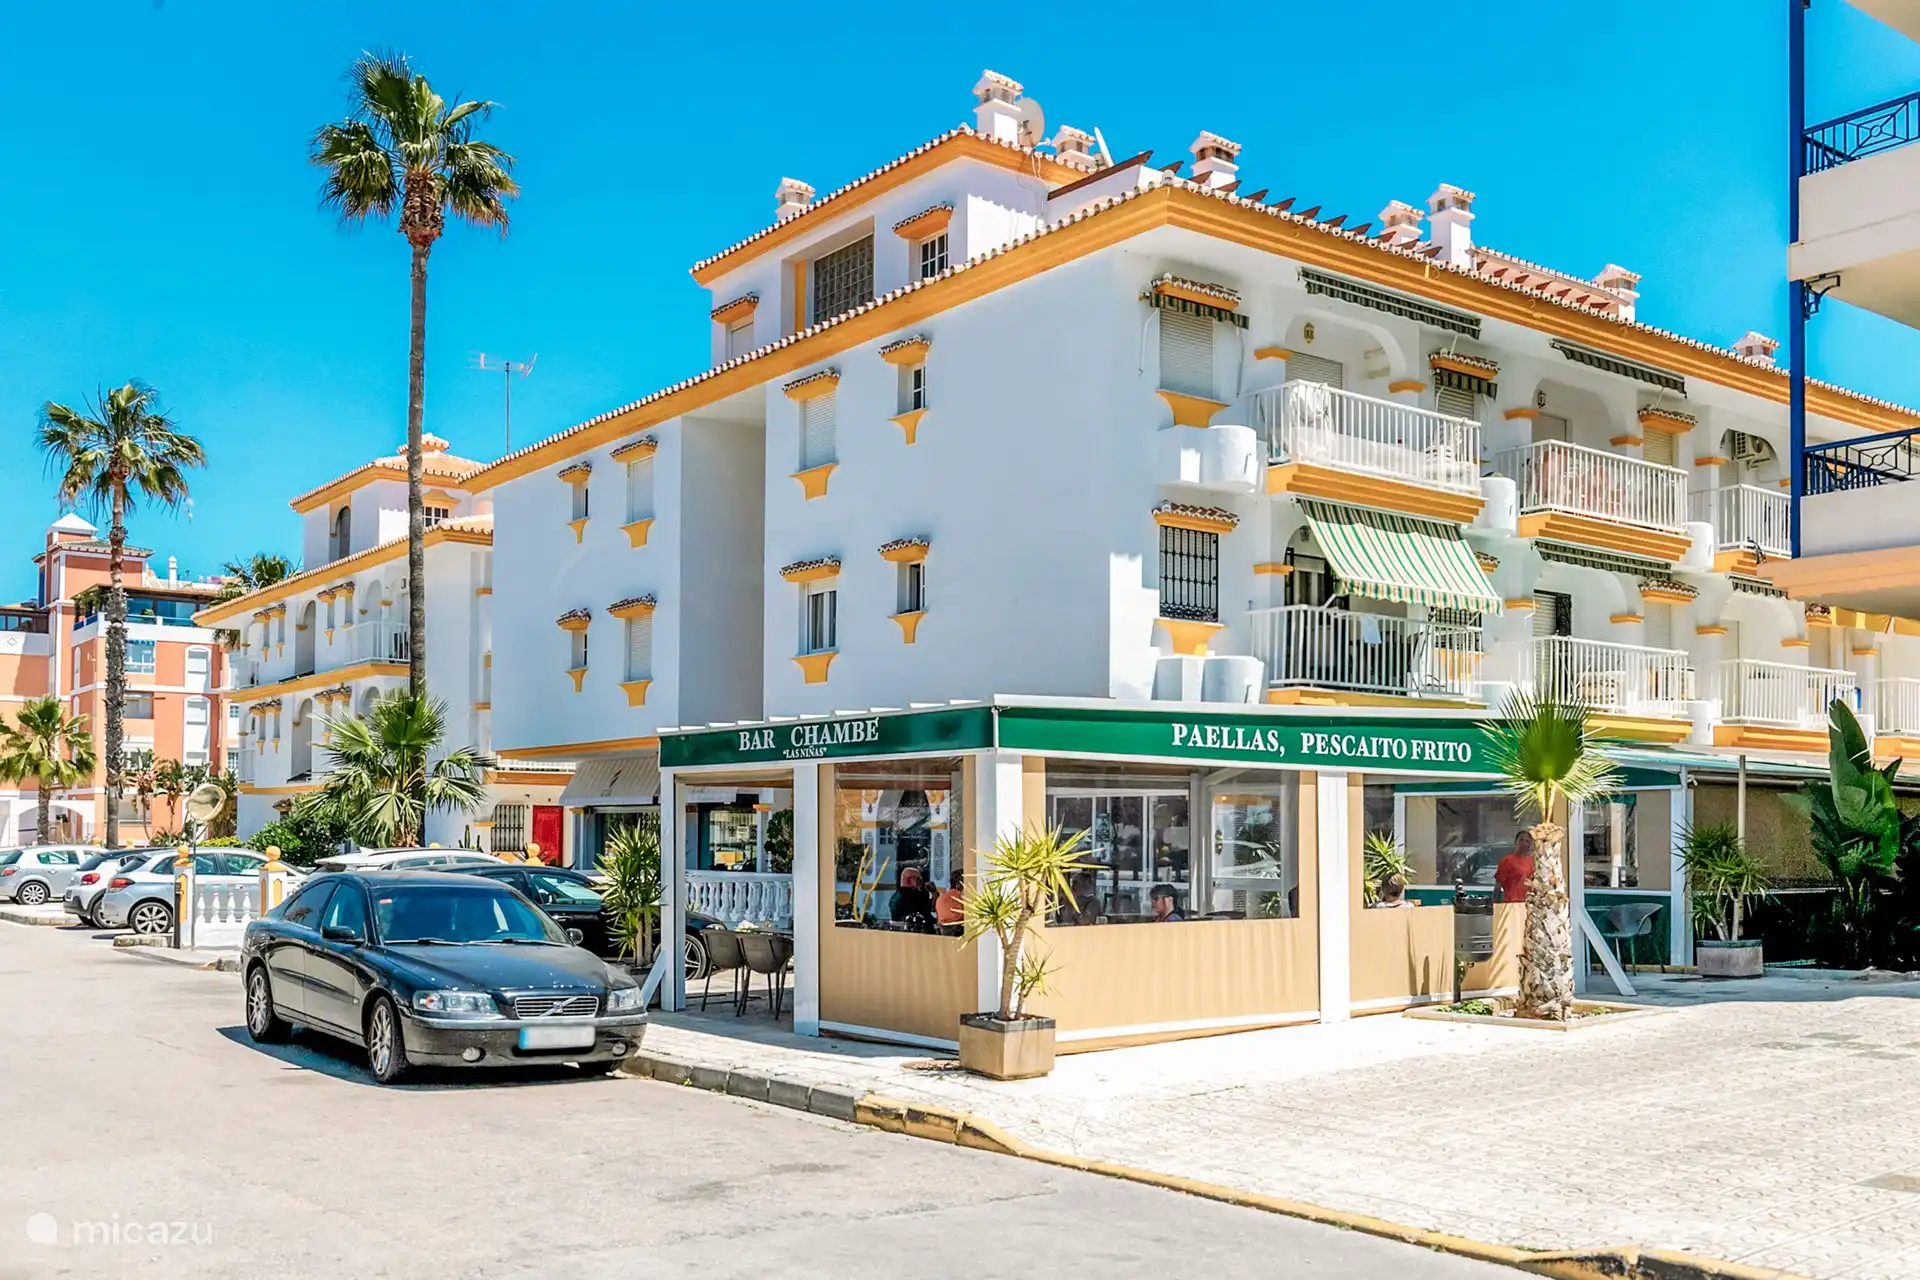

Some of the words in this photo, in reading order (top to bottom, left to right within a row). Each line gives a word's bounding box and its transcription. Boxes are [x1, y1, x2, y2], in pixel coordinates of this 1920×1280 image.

[738, 729, 776, 751] BAR
[1171, 723, 1286, 758] PAELLAS,
[1300, 732, 1407, 760] PESCAITO
[1410, 739, 1472, 763] FRITO
